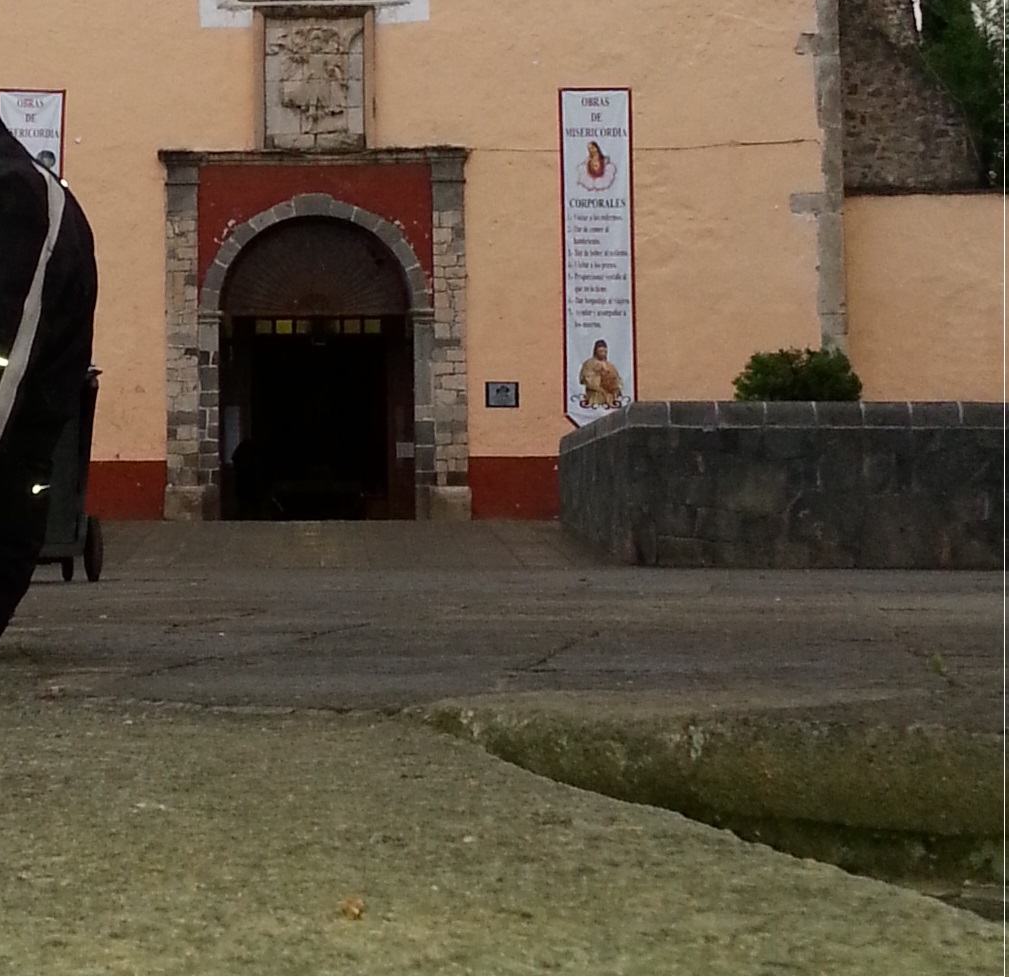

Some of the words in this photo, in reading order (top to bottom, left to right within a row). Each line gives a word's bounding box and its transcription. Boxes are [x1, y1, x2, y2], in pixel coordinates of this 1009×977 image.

[16, 98, 44, 108] OBRAS
[581, 97, 610, 107] OBRAS
[25, 113, 37, 123] DE
[591, 112, 602, 122] DE
[9, 128, 59, 138] ERICORDIA
[565, 127, 627, 137] MISERICORDIA
[569, 198, 626, 208] CORPORALES
